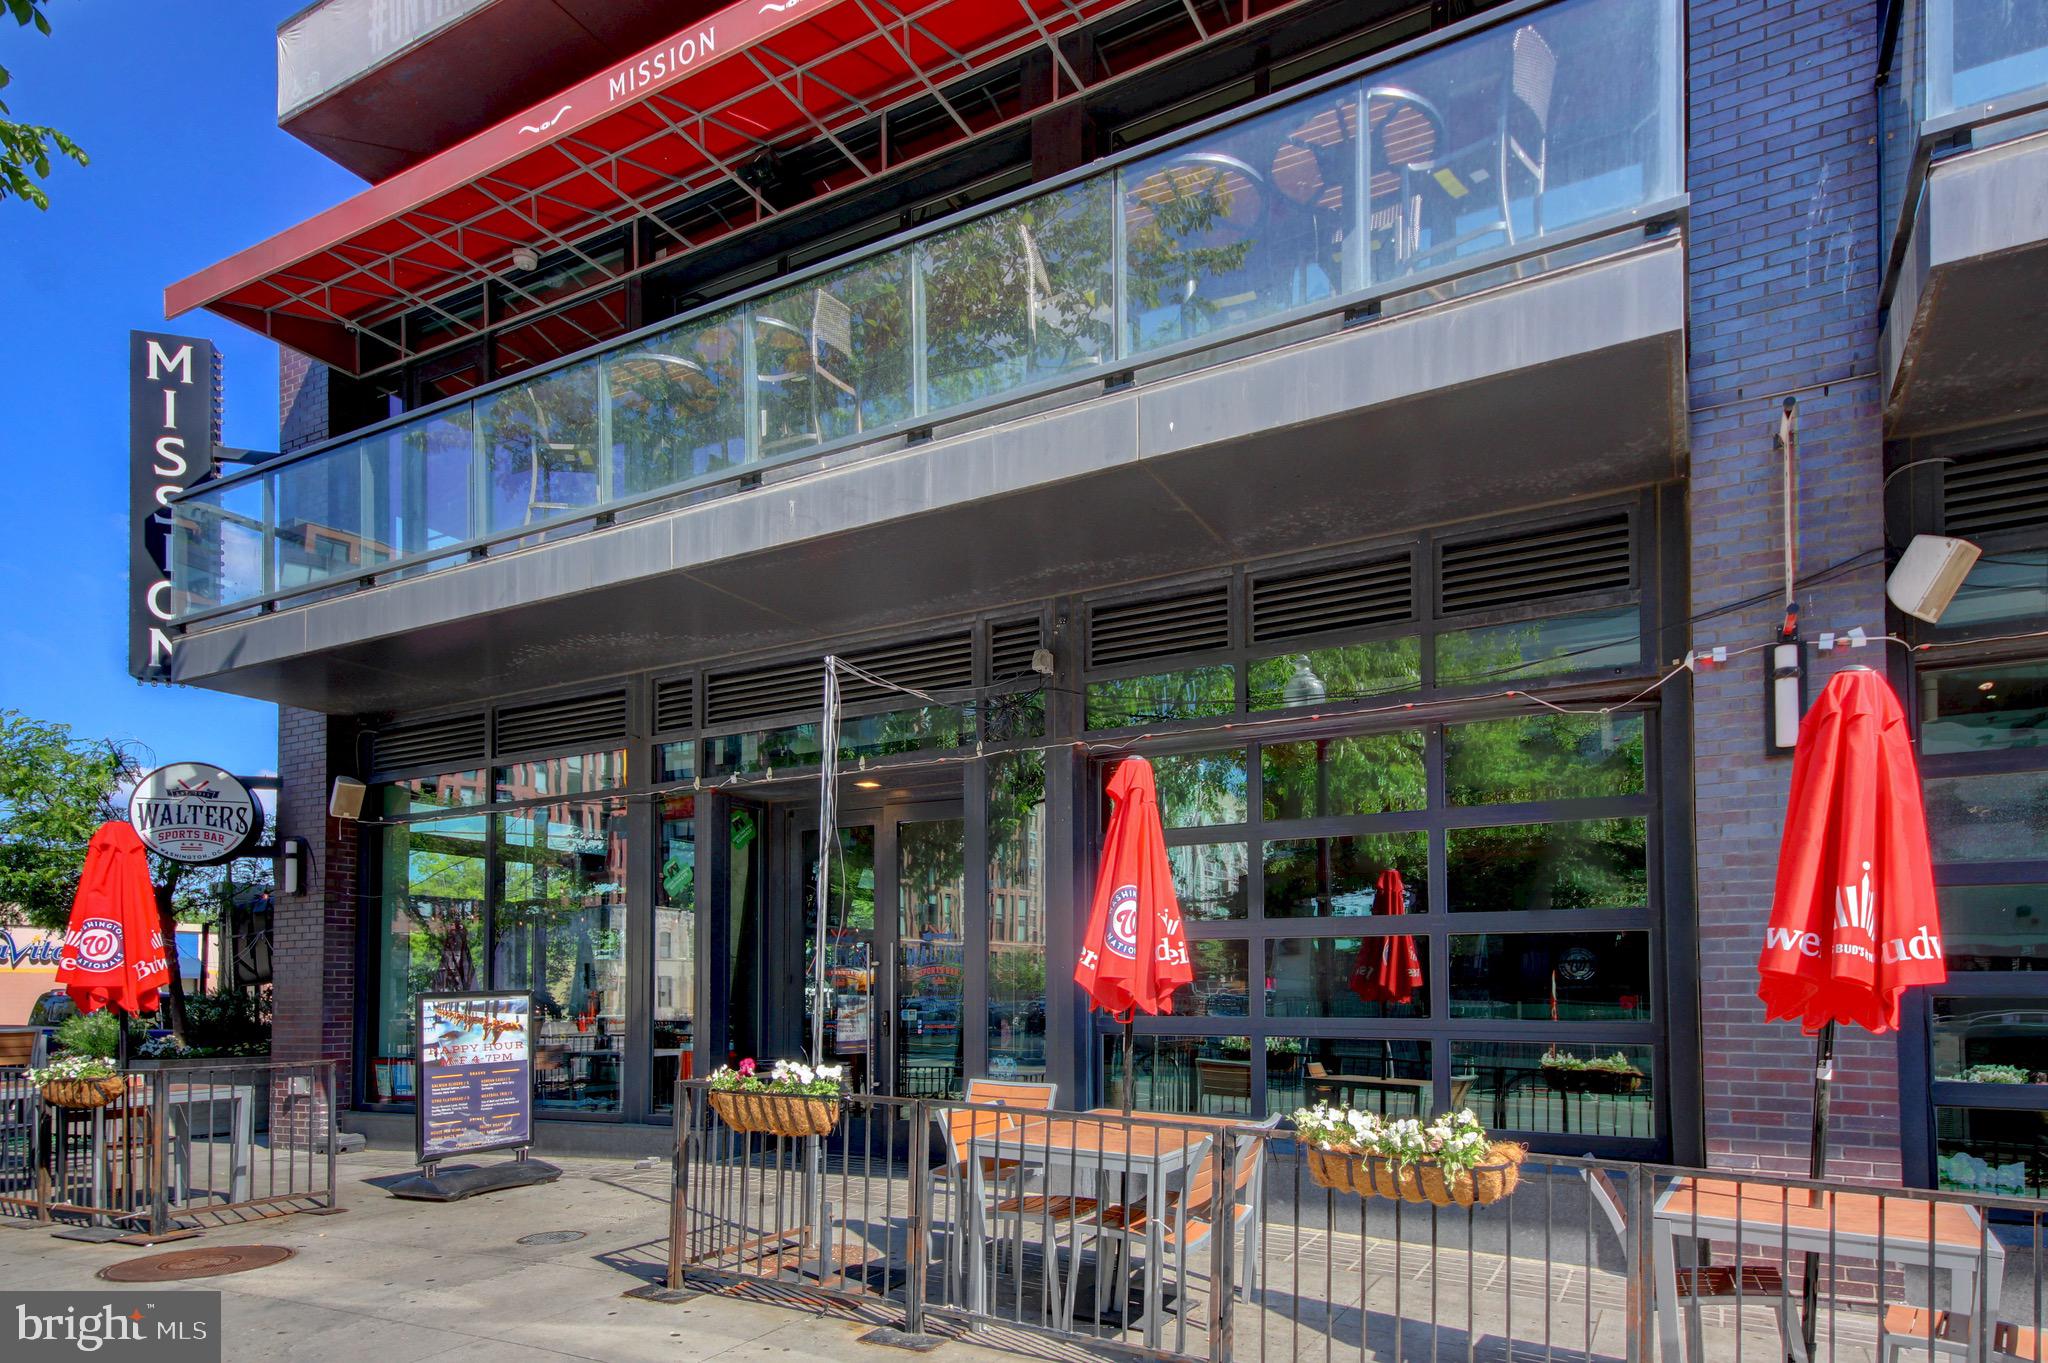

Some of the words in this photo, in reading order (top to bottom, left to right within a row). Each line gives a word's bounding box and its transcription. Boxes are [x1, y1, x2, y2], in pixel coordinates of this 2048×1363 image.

[609, 27, 716, 101] MISSION
[137, 803, 249, 835] WALTERS
[158, 830, 201, 841] SPORTS
[203, 831, 225, 843] BAR
[428, 1044, 478, 1056] HAPPY
[483, 1041, 524, 1052] HOUR
